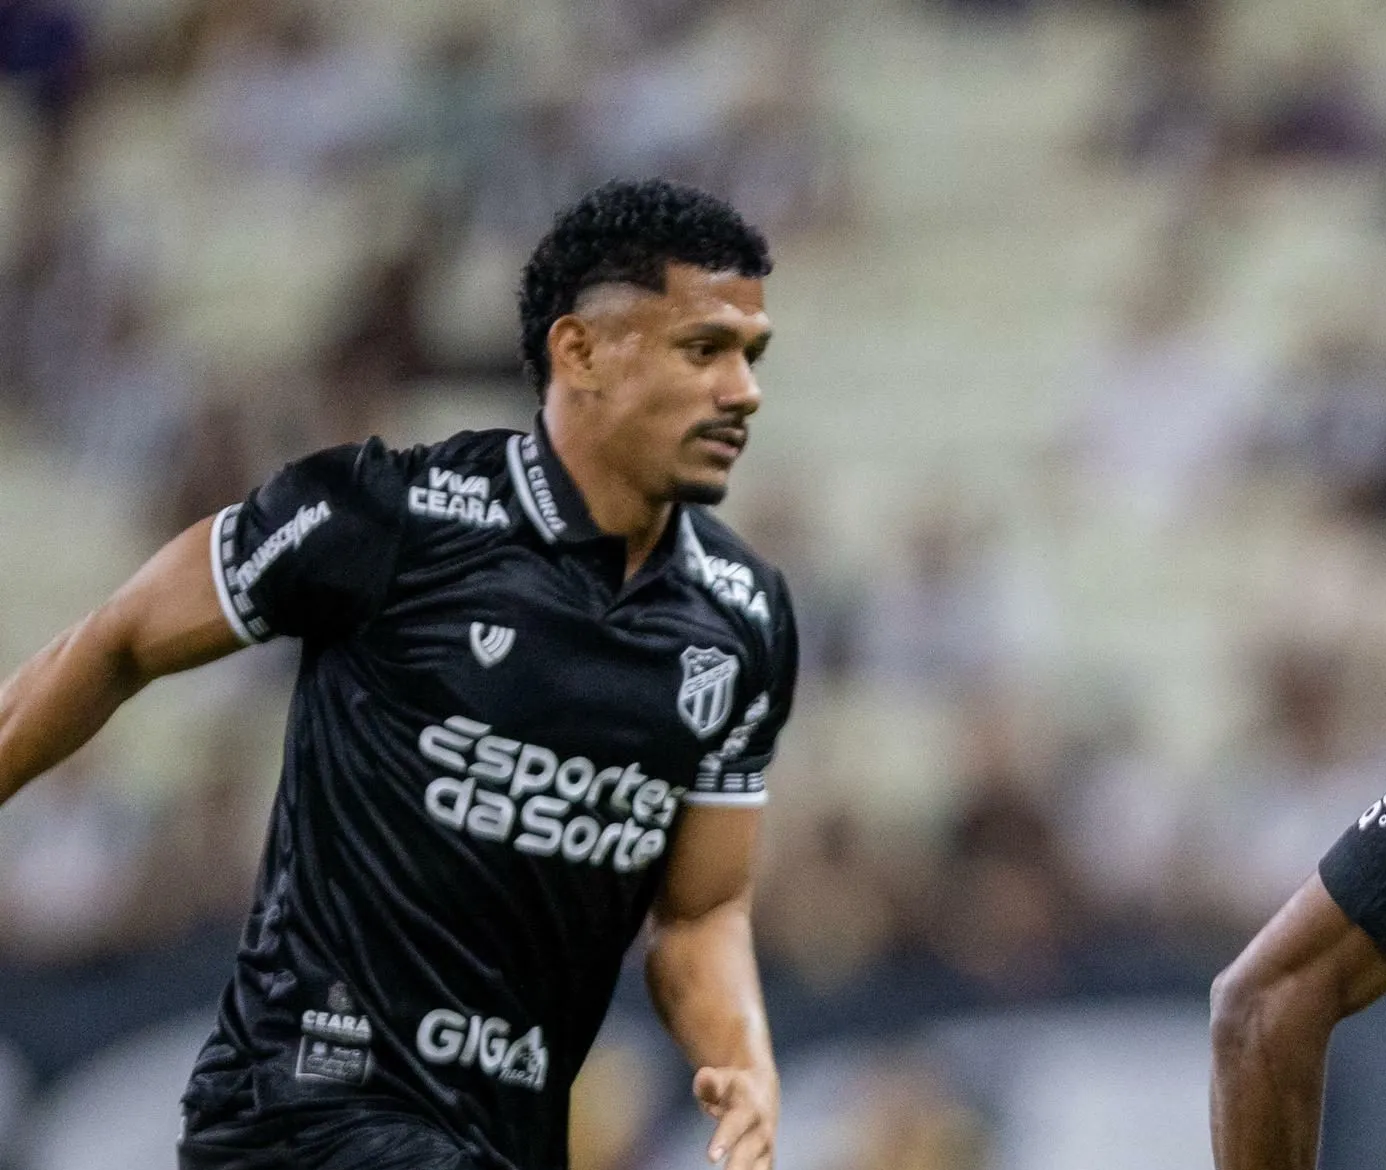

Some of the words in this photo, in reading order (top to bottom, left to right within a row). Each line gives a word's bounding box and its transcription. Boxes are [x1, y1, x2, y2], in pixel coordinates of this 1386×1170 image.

[428, 466, 491, 501] VIVA
[408, 484, 511, 530] CEARÁ
[418, 714, 687, 829] Esportes
[302, 1009, 372, 1041] CEARÁ
